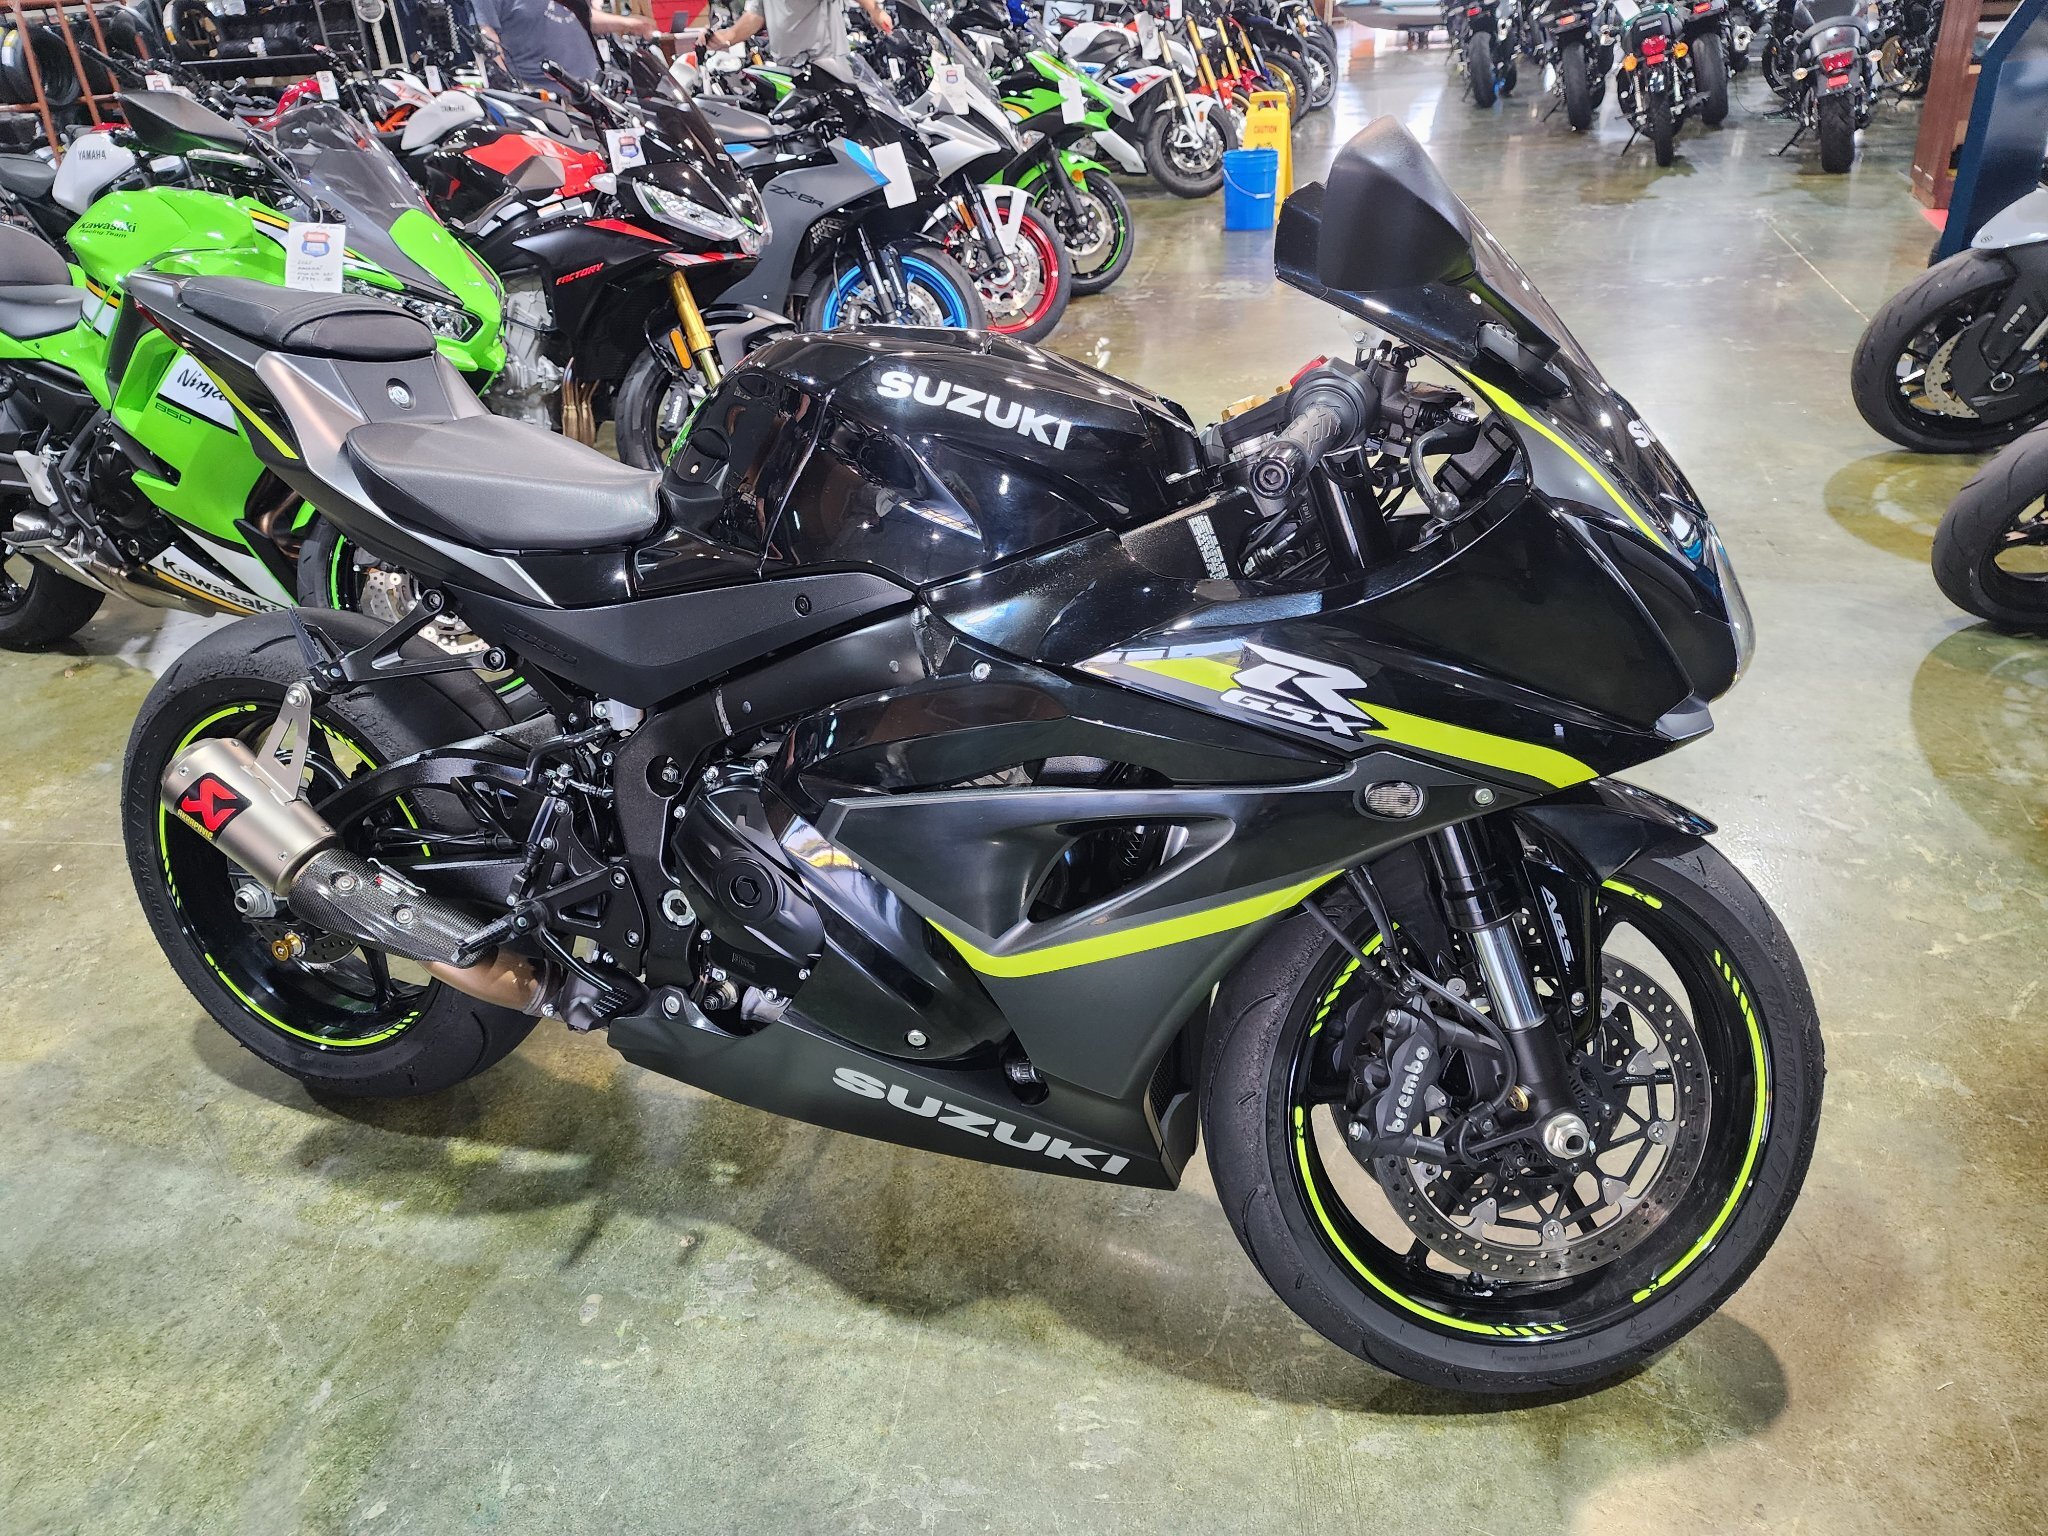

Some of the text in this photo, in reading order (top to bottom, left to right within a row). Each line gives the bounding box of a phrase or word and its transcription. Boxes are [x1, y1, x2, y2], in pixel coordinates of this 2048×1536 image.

[78, 150, 107, 160] YAMAHA
[769, 184, 824, 208] ZX-6R
[555, 262, 605, 286] FACTORY
[155, 402, 192, 425] 650
[876, 370, 1073, 451] SUZUKI
[1385, 1045, 1430, 1133] brembo
[832, 1067, 1131, 1176] SUZUKI
